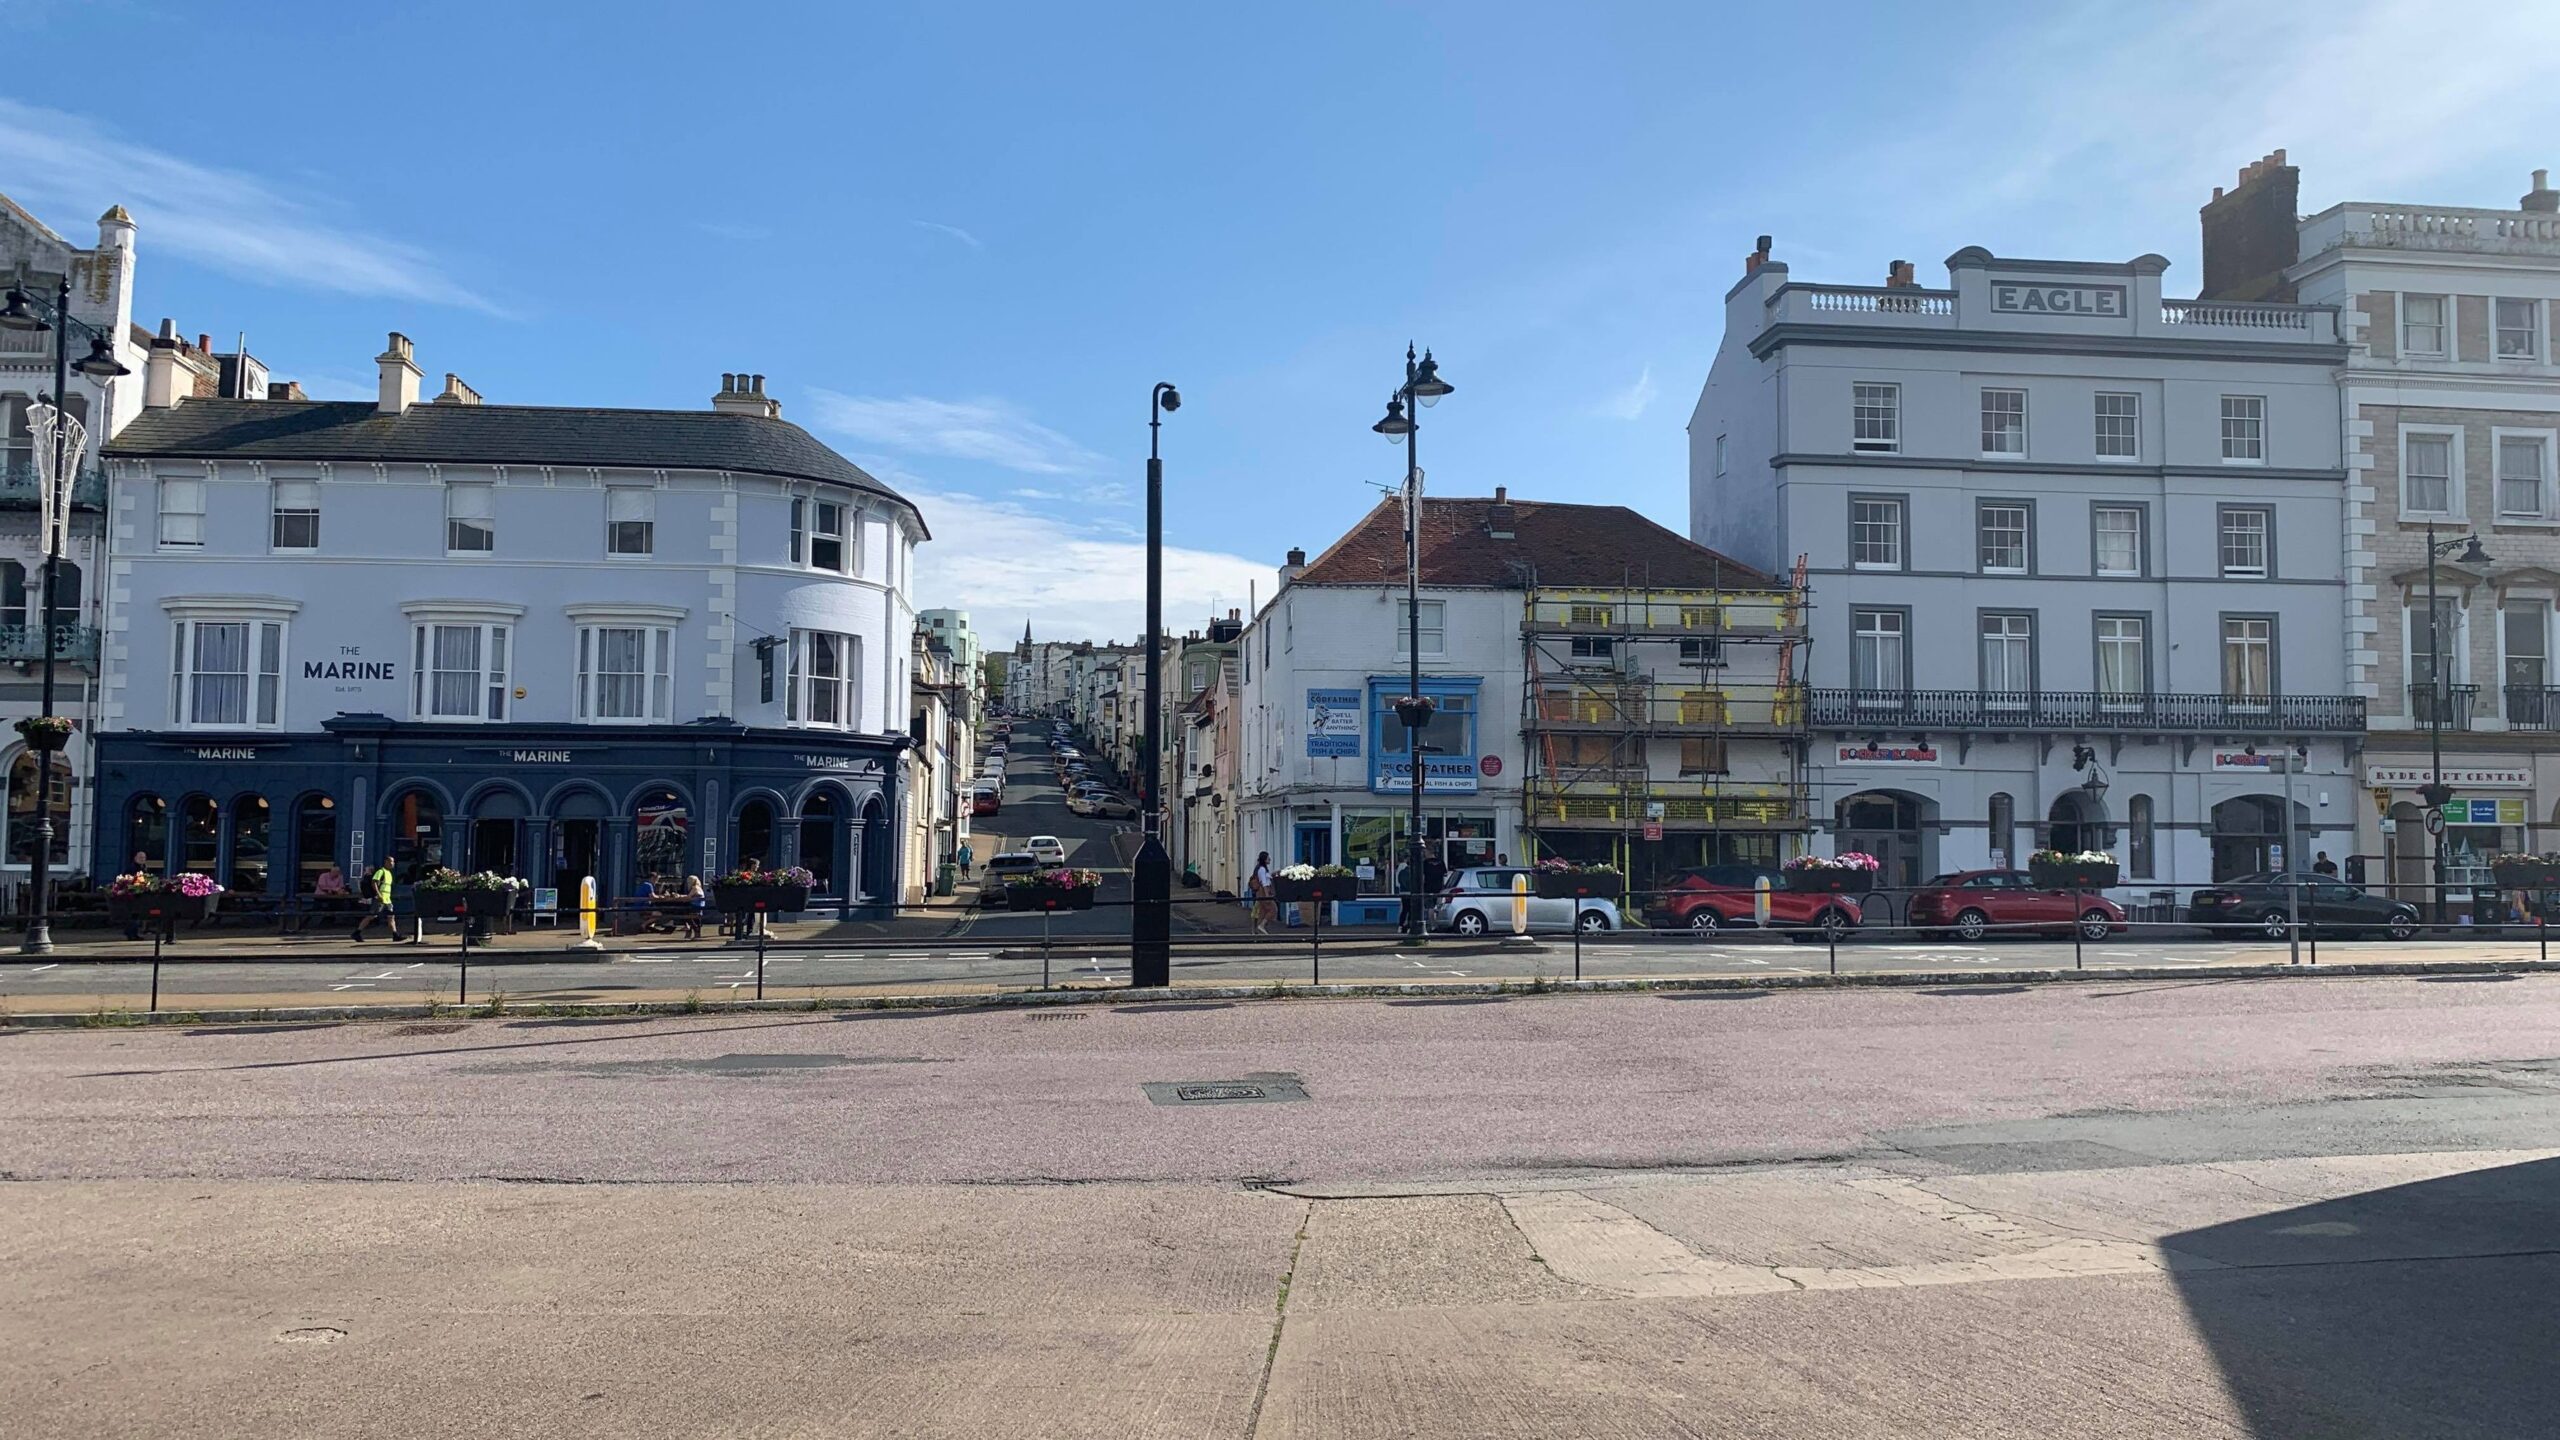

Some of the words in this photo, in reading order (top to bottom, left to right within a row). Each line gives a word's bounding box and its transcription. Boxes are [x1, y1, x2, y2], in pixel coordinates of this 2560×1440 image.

[1999, 287, 2115, 313] EAGLE
[340, 646, 360, 656] THE
[304, 661, 395, 680] MARINE
[1311, 696, 1360, 704] CODFATHER
[198, 747, 256, 759] MARINE
[513, 750, 571, 762] MARINE
[806, 755, 849, 769] MARINE
[1396, 764, 1472, 774] COFATHER
[2376, 771, 2417, 780] RYDE
[2422, 772, 2461, 781] GFT
[2466, 773, 2527, 781] CENTRE
